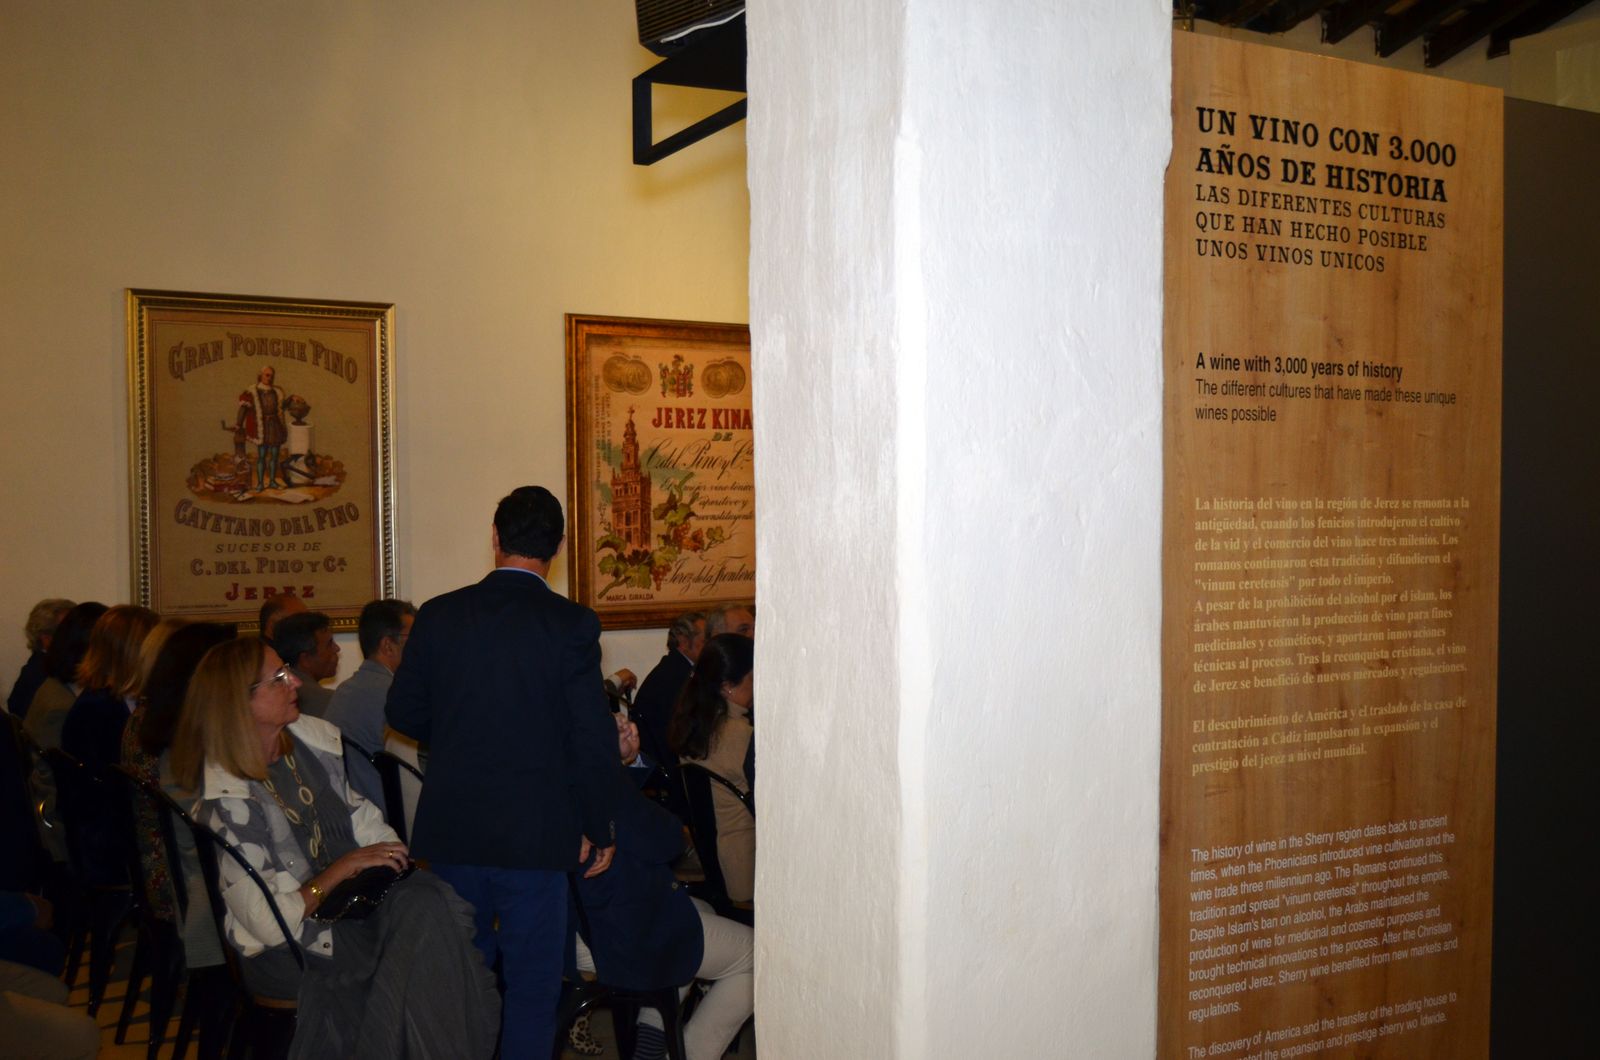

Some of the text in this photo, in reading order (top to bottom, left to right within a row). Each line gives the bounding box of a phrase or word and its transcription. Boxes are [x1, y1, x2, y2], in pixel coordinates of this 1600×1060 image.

[1196, 106, 1457, 167] UN VINO CON 3.000
[1196, 143, 1448, 202] AÑOS DE HISTORIA
[1196, 184, 1446, 229] LAS DIFERENTES CULTURAS
[1196, 211, 1428, 251] QUE HAN HECHO POSIBLE
[1196, 238, 1385, 272] UNOS VINOS UNICOS
[168, 331, 358, 384] GRAN PONCHE PINO
[1196, 352, 1403, 383] A wine with 3,000 years of history
[1196, 378, 1457, 408] The different cultures that have made these unique
[652, 407, 707, 429] JEREZ
[1195, 404, 1277, 424] wines possible
[174, 498, 360, 537] CAYETANO DEL PINO
[1195, 497, 1210, 510] La
[1213, 497, 1254, 510] historia
[1257, 497, 1273, 510] del
[1275, 497, 1298, 510] vino
[1300, 500, 1312, 509] en
[1315, 497, 1324, 509] la
[1327, 497, 1358, 512] región
[1361, 497, 1372, 509] de
[1374, 497, 1399, 509] Jerez
[1401, 499, 1412, 509] se
[1413, 498, 1451, 509] remonta
[1461, 496, 1470, 508] la
[1195, 515, 1461, 533] antigüedad, cuando los fenicios introdujeron el cultivo
[216, 542, 322, 554] SUCESOR DE
[1194, 560, 1241, 572] romanos
[1244, 556, 1307, 570] continuaron
[1310, 557, 1329, 568] esta
[1332, 553, 1376, 567] tradición
[1386, 552, 1440, 566] difundieron
[1442, 552, 1451, 564] el
[215, 558, 251, 576] DEL
[256, 556, 304, 575] PINO
[307, 560, 320, 573] Y
[225, 582, 315, 601] JEREZ
[1195, 572, 1394, 591] "vinum ceretensis" por todo el imperio.
[1194, 607, 1453, 632] árabes mantuvieron la producción de vino para fines
[1194, 637, 1256, 653] medicinales
[1267, 633, 1325, 648] cosméticos,
[1336, 631, 1385, 646] aportaron
[1386, 627, 1446, 641] innovaciones
[1192, 757, 1239, 776] prestigio
[1241, 754, 1258, 768] del
[1259, 753, 1286, 769] jerez
[1297, 747, 1321, 762] nivel
[1323, 743, 1367, 759] mundial.
[1191, 815, 1448, 862] The history of wine in the Sherry region dates back to ancient
[1190, 832, 1455, 883] times, when the Phoenicians introduced vine cultivation and the
[1190, 905, 1227, 922] tradition
[1229, 900, 1247, 915] and
[1249, 895, 1280, 914] spread
[1361, 874, 1406, 893] throughout
[1407, 872, 1420, 886] the
[1421, 869, 1450, 884] empire.
[1188, 1001, 1241, 1022] regulations.
